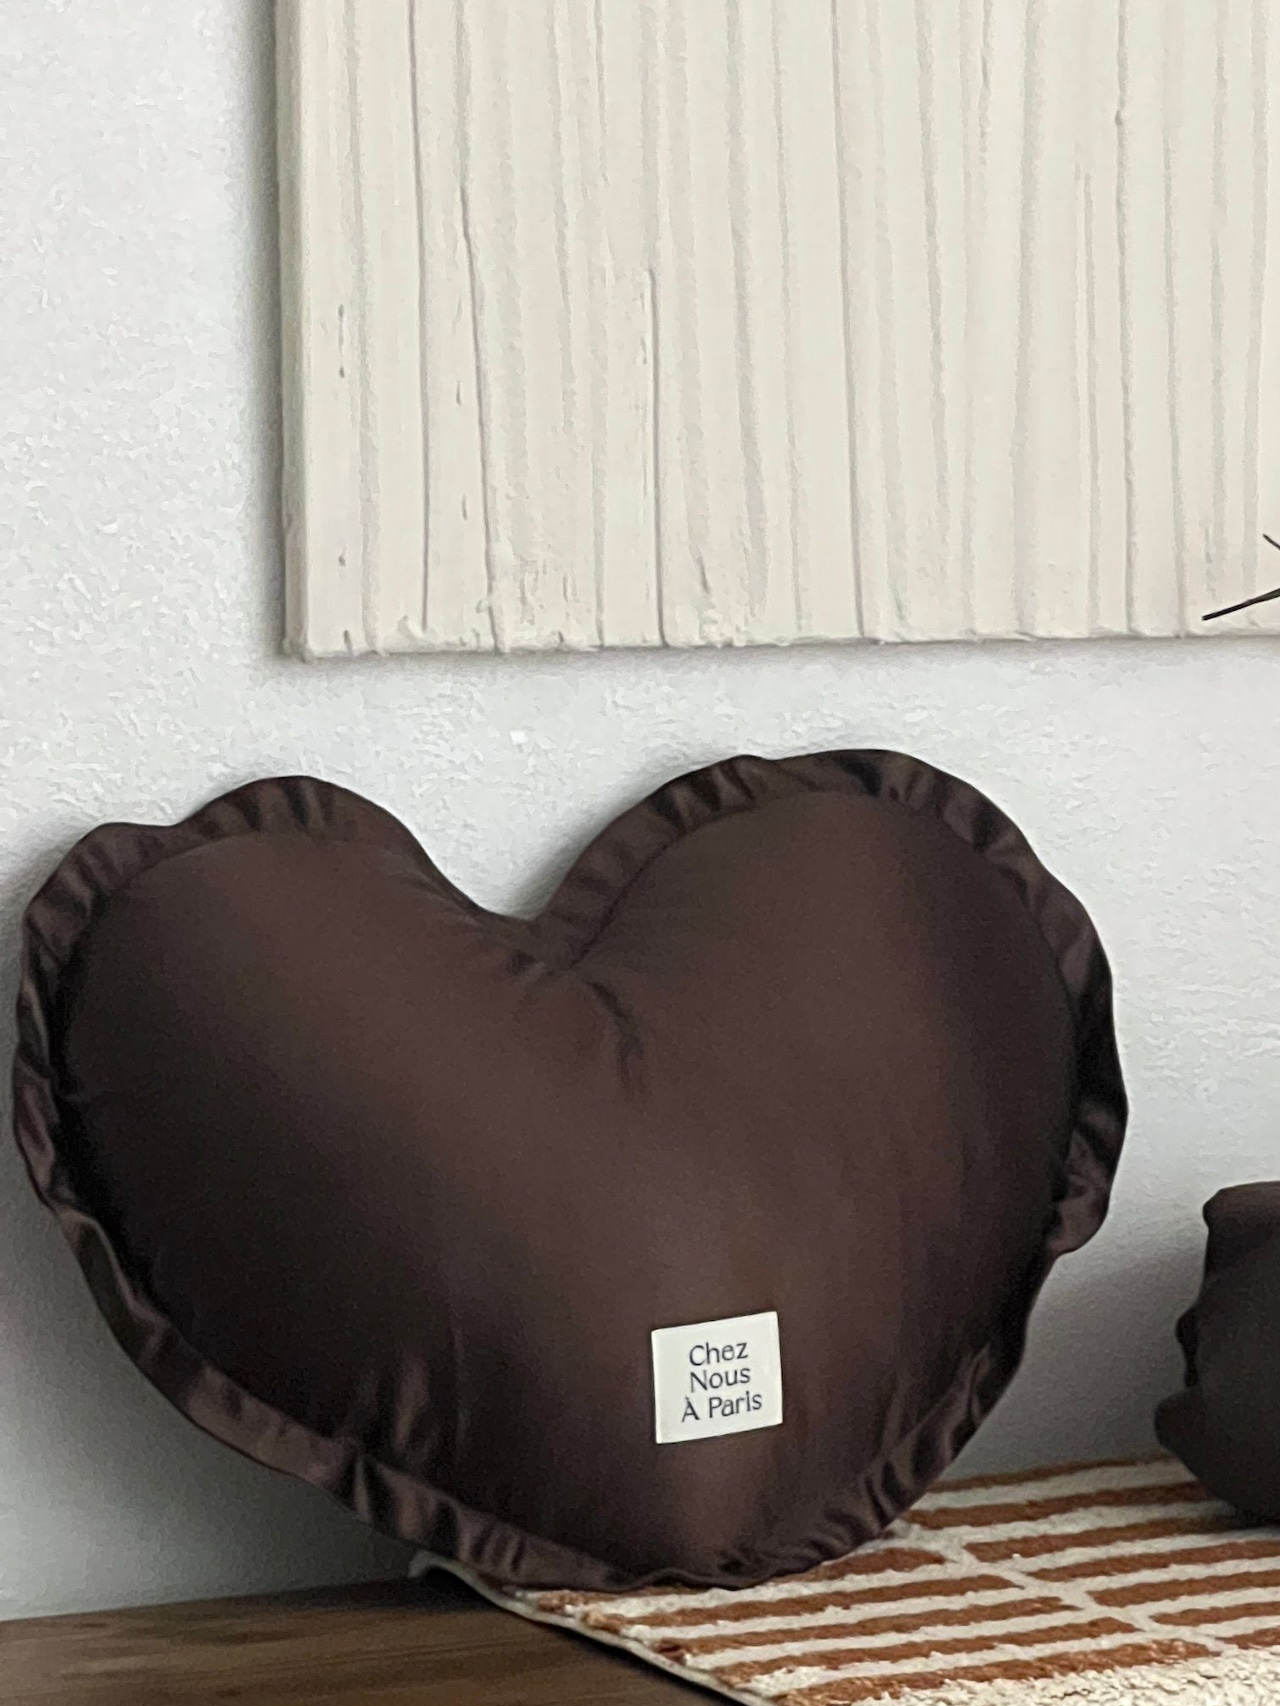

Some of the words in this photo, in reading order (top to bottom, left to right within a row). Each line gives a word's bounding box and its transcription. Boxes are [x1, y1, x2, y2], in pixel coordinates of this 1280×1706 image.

[689, 1341, 748, 1367] Chez
[690, 1367, 751, 1393] Nous
[681, 1396, 701, 1423] À
[708, 1390, 763, 1419] Paris
